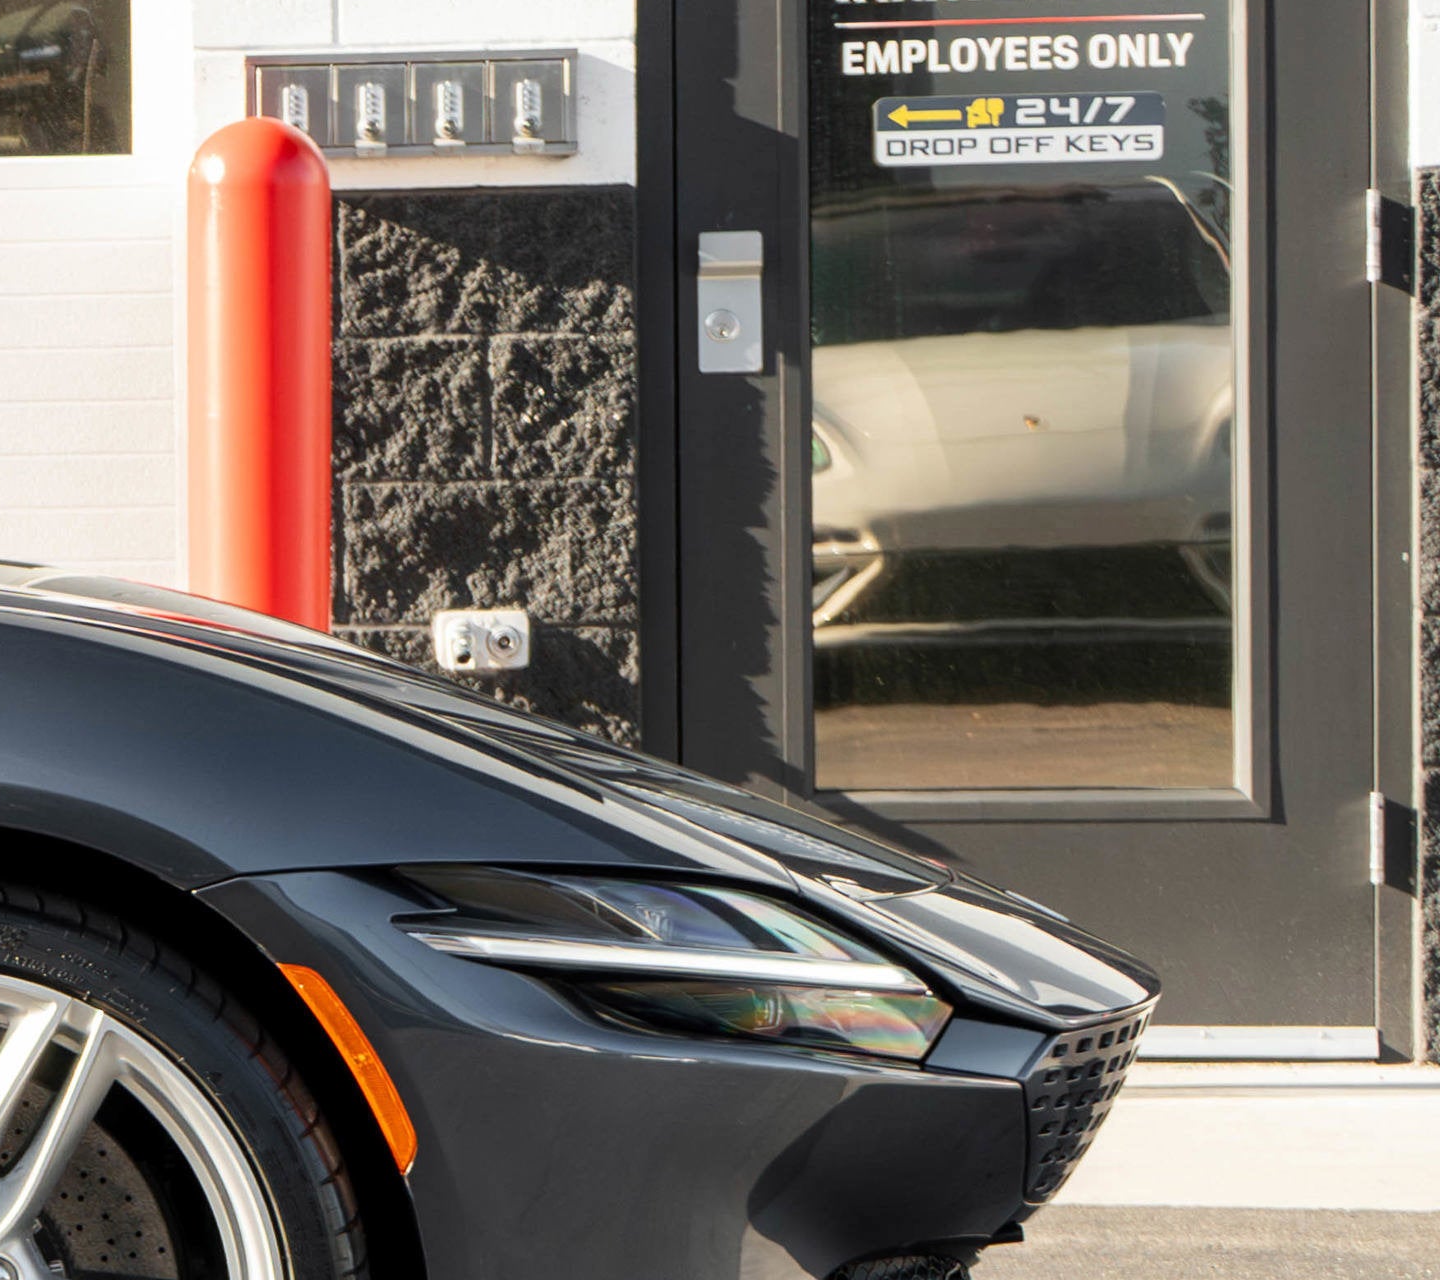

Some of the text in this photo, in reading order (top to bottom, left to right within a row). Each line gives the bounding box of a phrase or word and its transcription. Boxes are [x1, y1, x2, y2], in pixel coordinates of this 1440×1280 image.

[841, 32, 1194, 76] EMPLOYEES ONLY
[1015, 97, 1136, 126] 24/7
[887, 134, 1155, 157] DROP OFF KEYS
